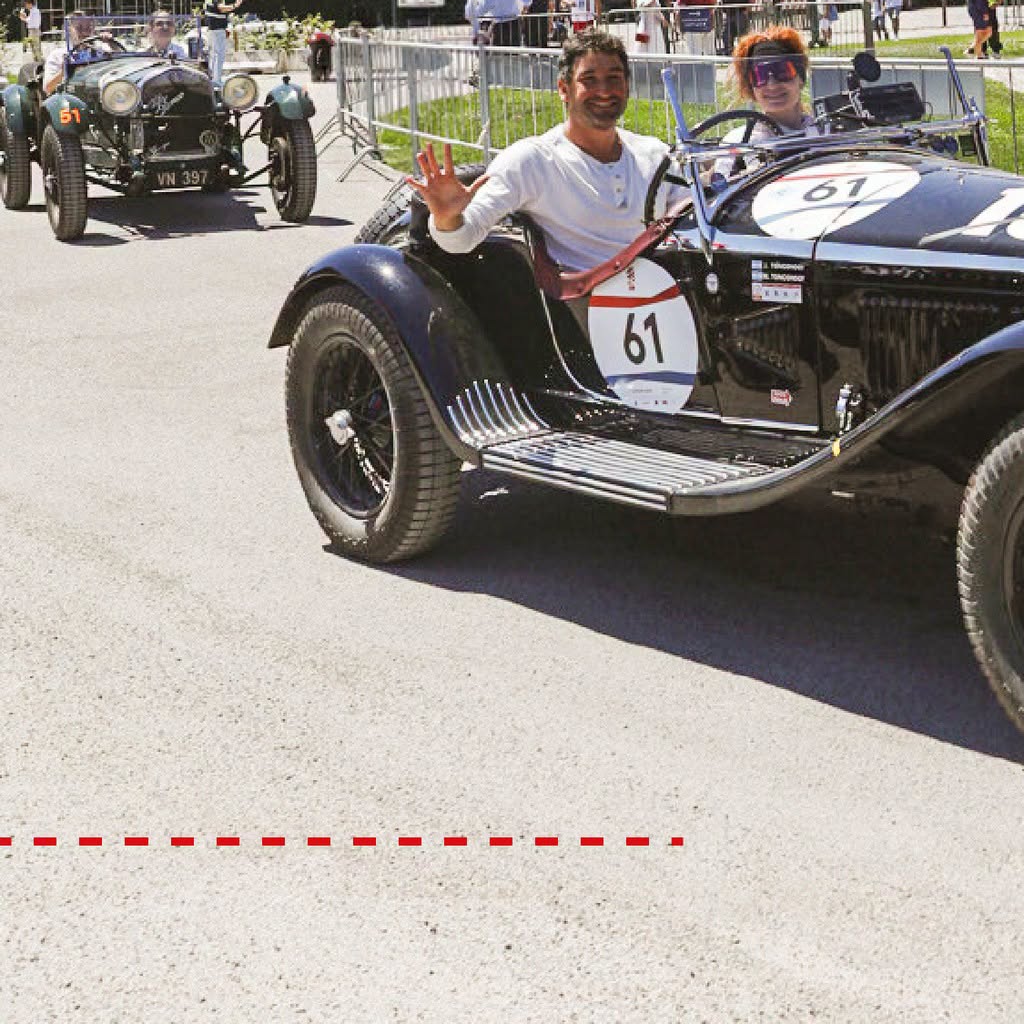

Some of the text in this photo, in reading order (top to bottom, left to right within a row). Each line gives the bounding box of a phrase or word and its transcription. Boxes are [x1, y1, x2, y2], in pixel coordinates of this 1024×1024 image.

[157, 170, 209, 185] VN 397
[802, 177, 868, 202] 61
[624, 312, 664, 365] 61
